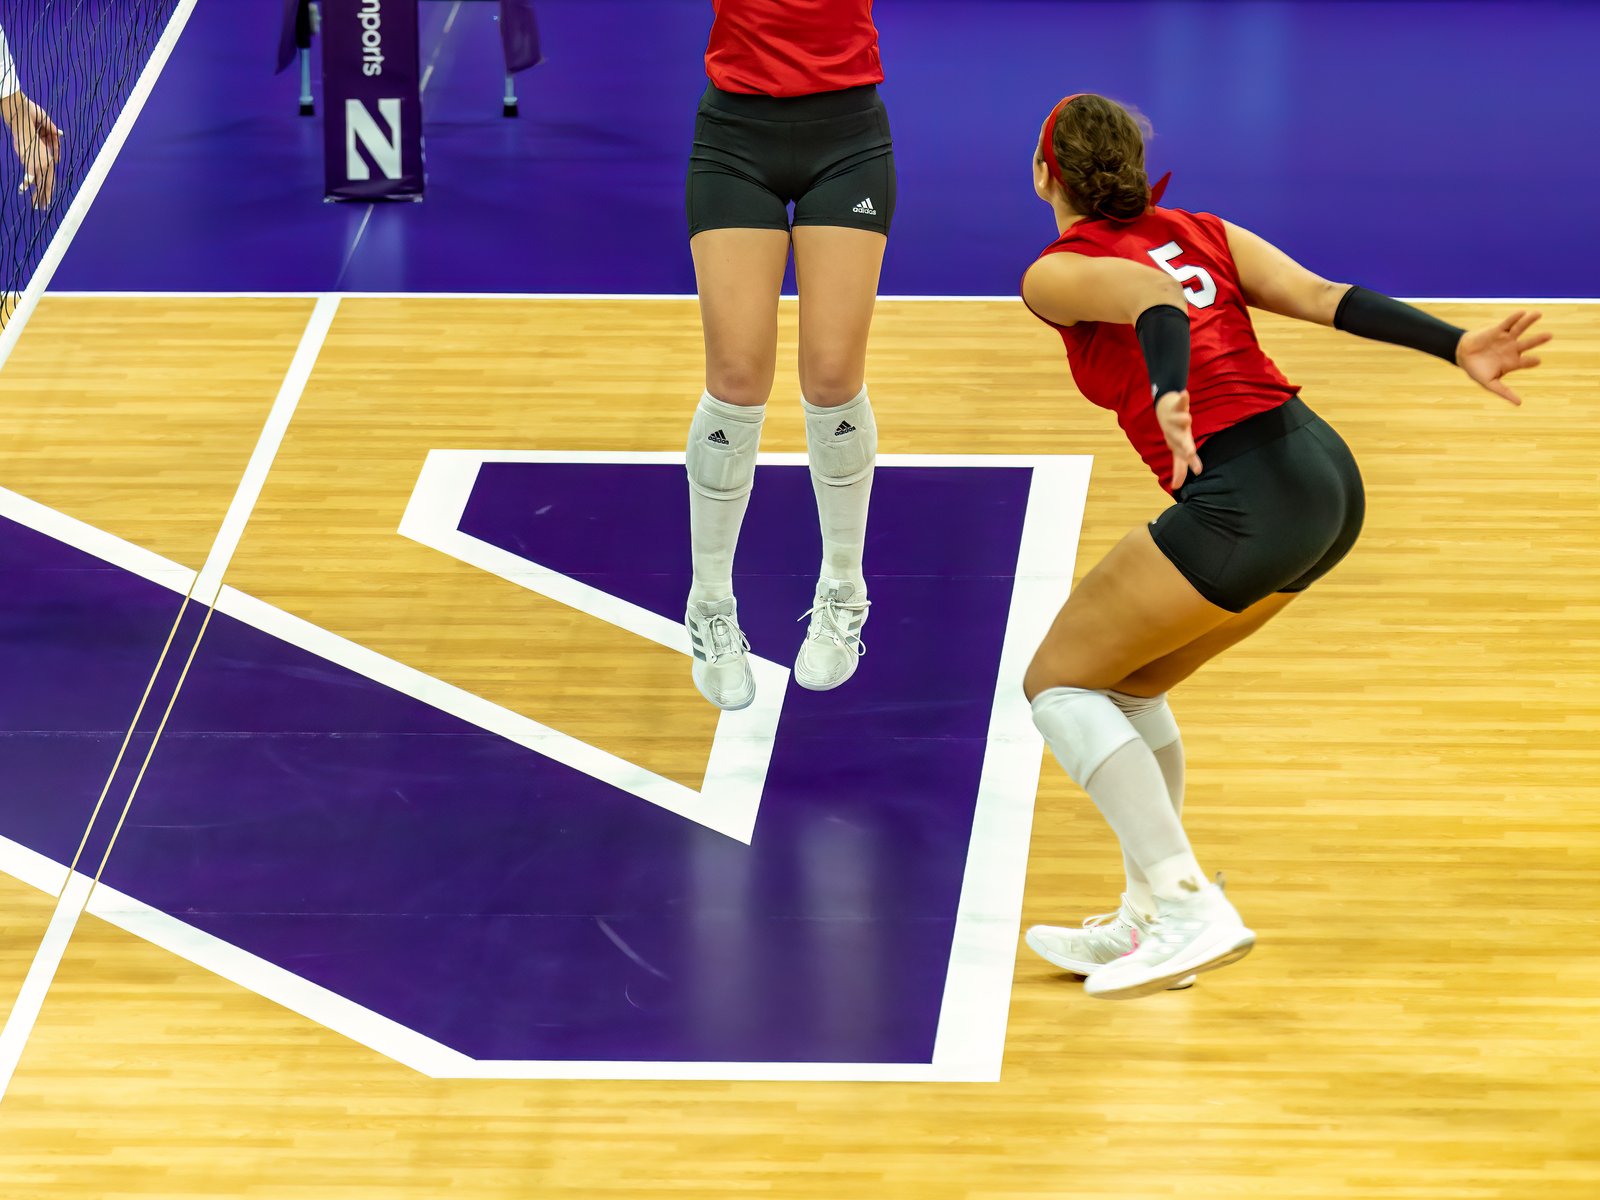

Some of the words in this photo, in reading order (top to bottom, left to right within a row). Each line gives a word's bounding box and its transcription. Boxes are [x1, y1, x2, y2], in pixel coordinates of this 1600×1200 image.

[346, 99, 402, 180] N
[852, 207, 877, 215] adidas
[1147, 240, 1217, 309] 5
[834, 425, 856, 436] adidas
[707, 435, 730, 445] adidas
